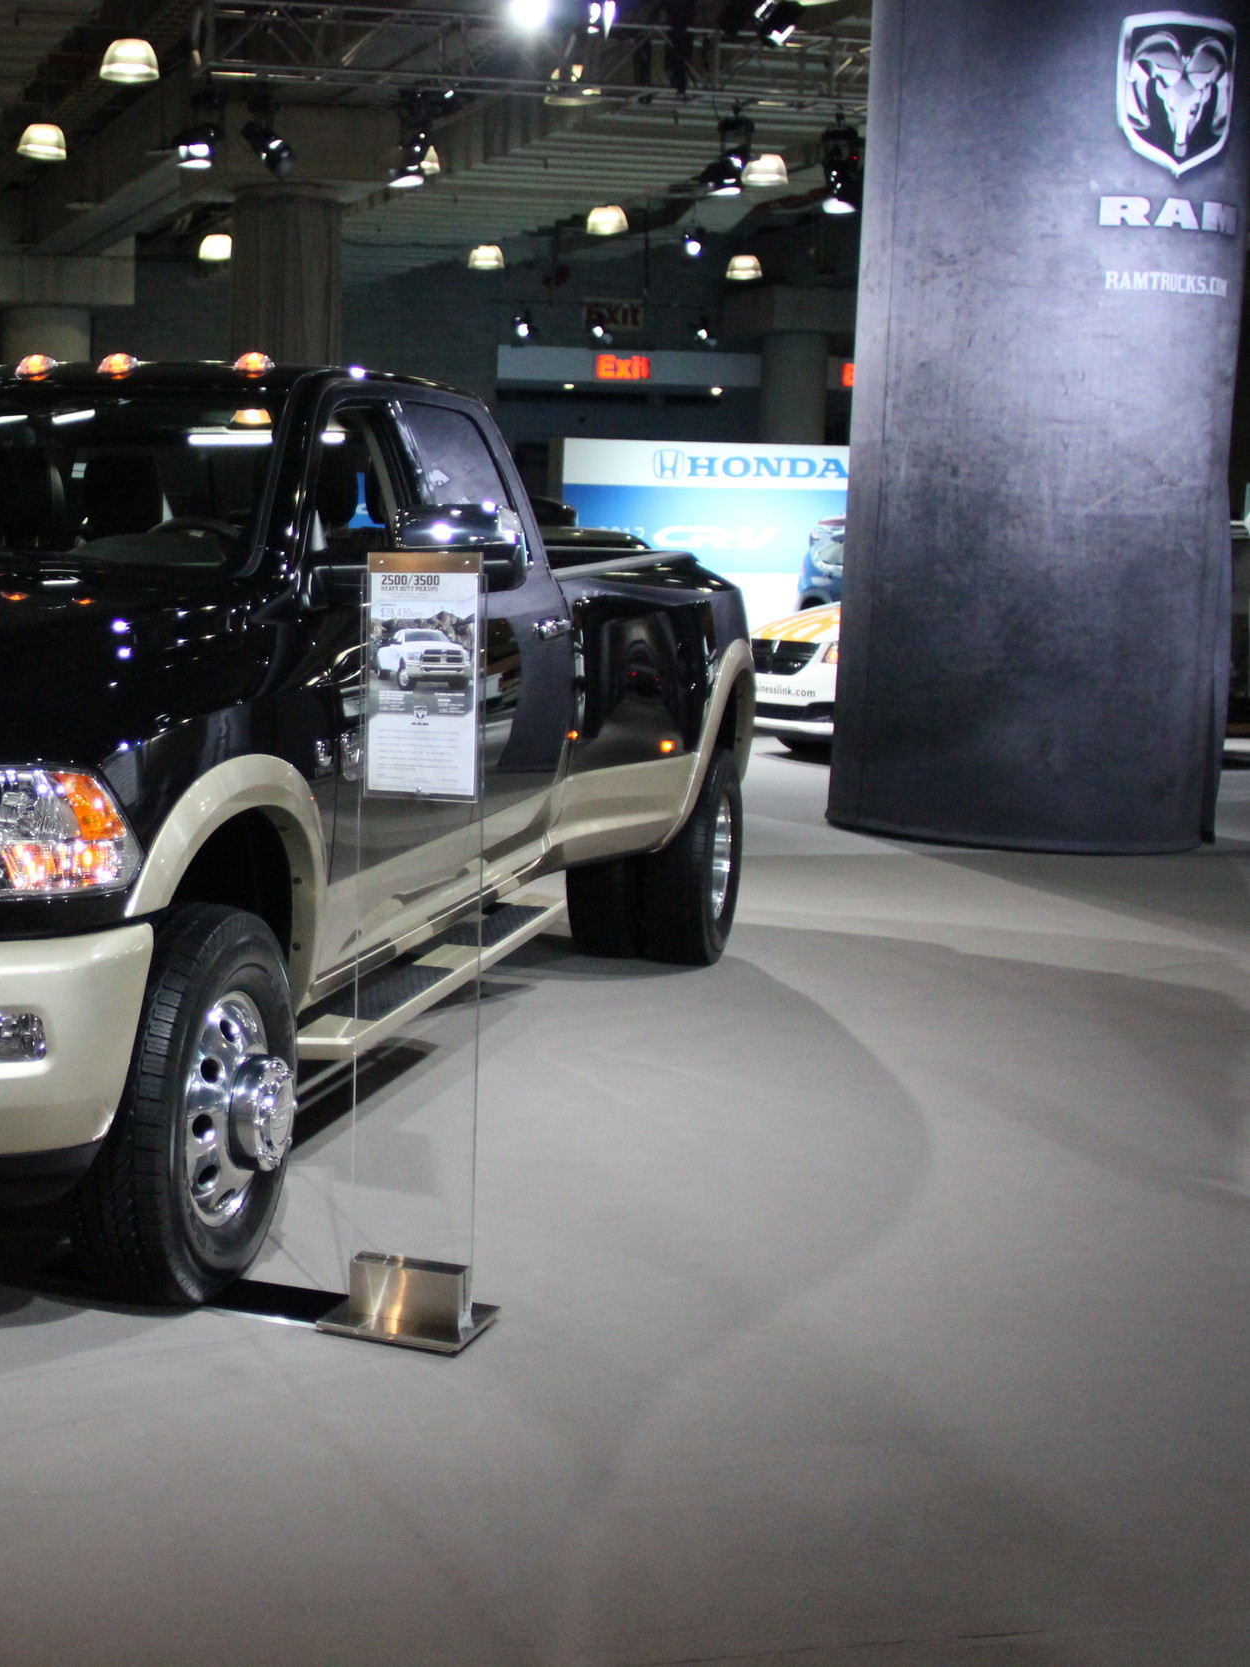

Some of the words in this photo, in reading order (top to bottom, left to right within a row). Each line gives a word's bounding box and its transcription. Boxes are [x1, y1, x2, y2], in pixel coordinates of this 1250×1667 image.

[1099, 196, 1237, 235] RAM
[1104, 271, 1228, 297] RAMTRUCKS.COM
[596, 354, 651, 379] Exit
[687, 456, 849, 479] HONDA
[381, 574, 440, 586] 2500/3500
